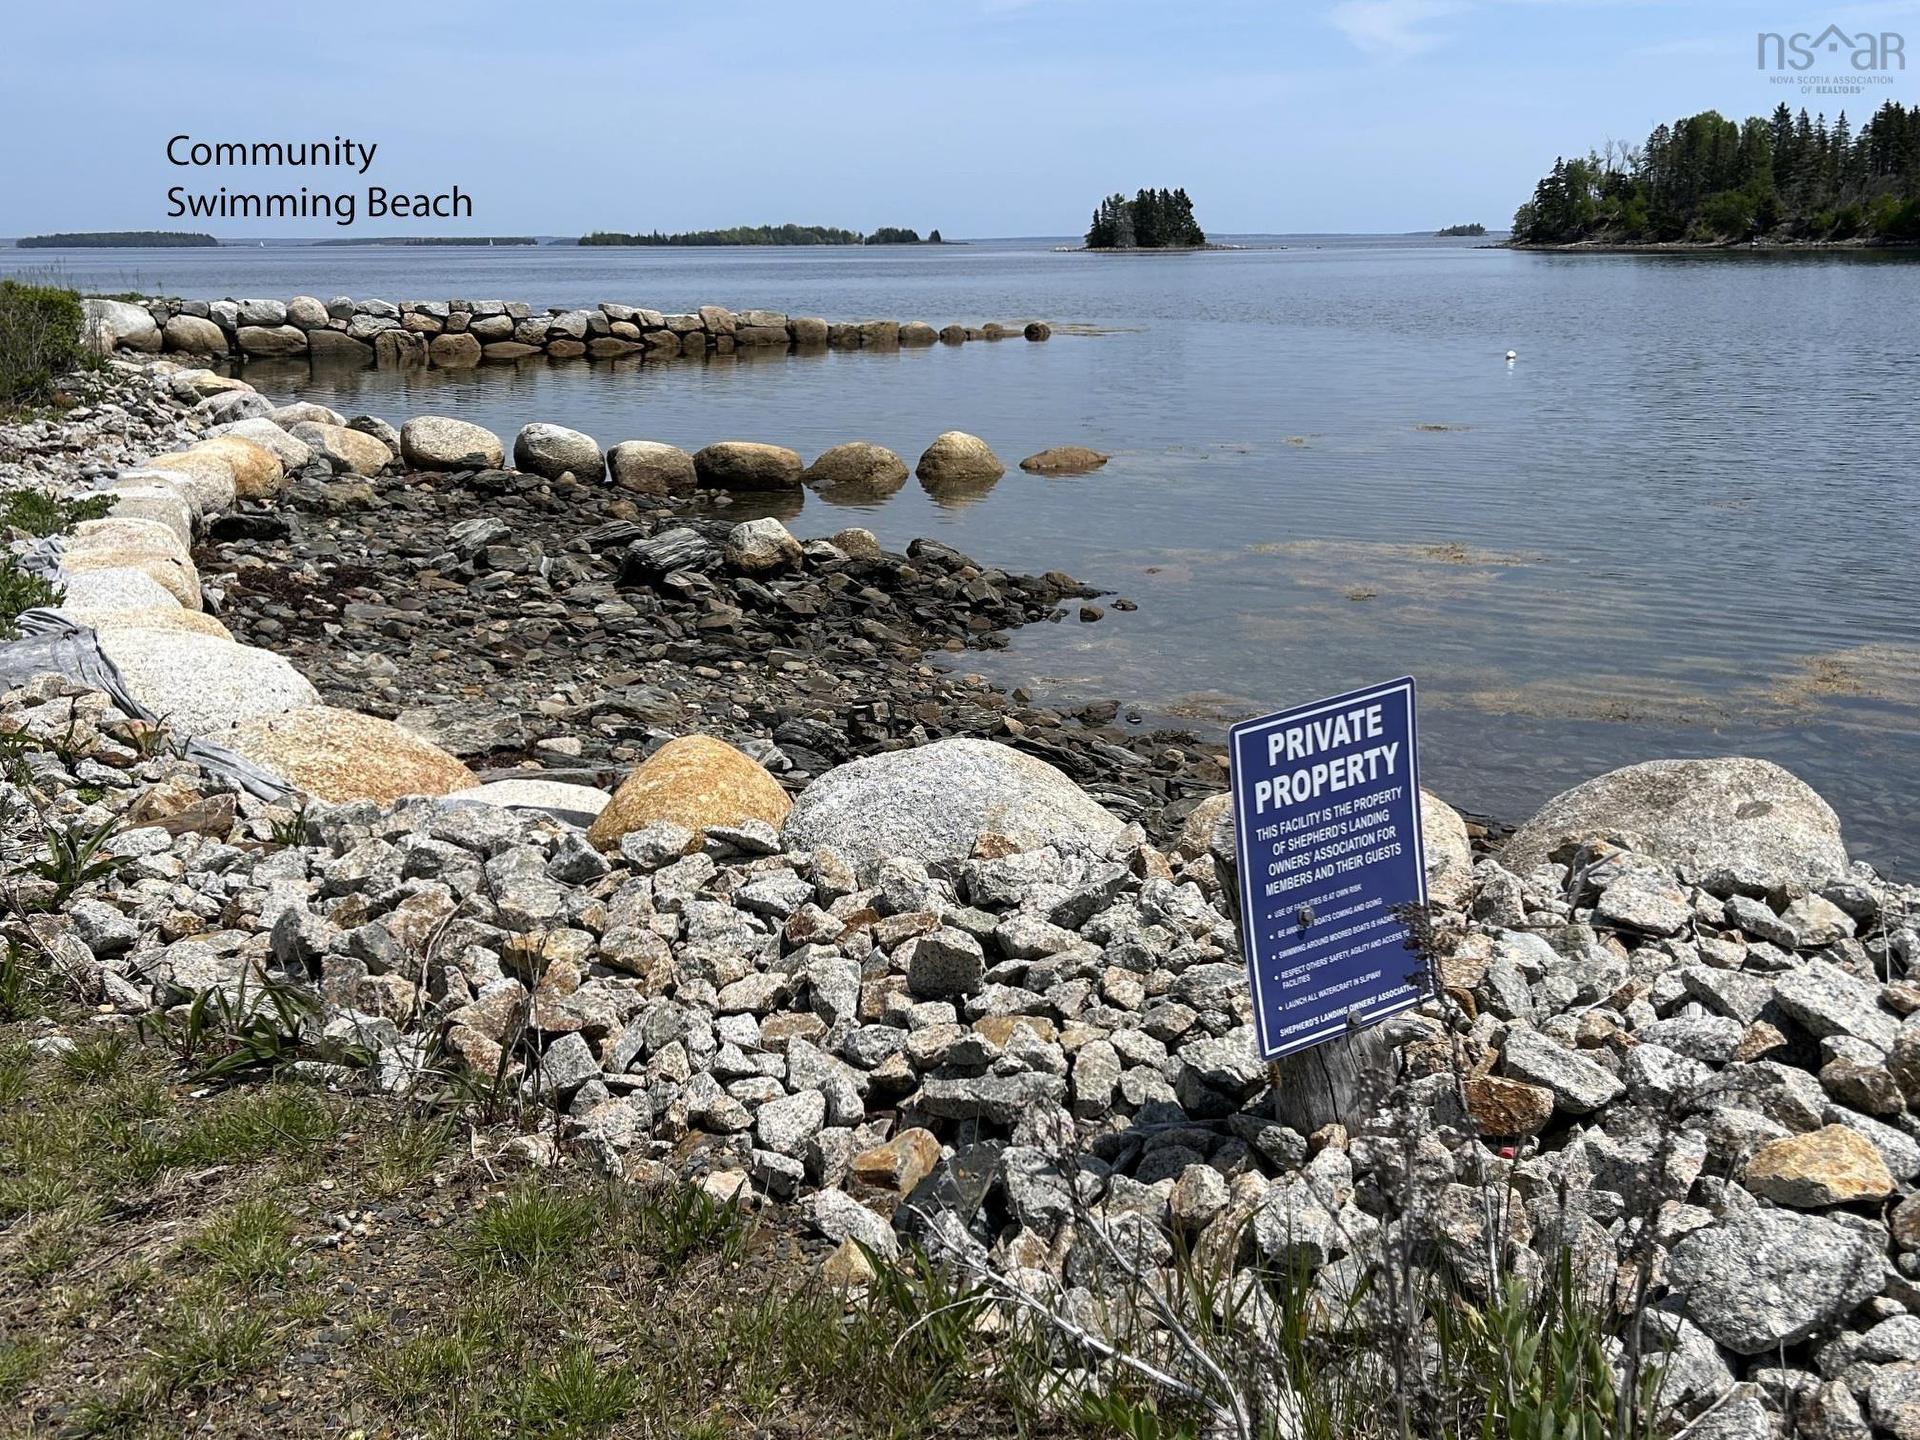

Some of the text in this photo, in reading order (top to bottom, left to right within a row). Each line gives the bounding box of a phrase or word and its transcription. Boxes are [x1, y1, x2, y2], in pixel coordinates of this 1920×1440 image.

[1267, 704, 1384, 767] PRIVATE
[1254, 741, 1399, 815] PROPERTY
[1256, 786, 1403, 842] THIS FACILITY IS THE PROPERTY
[1272, 809, 1390, 856] OF SHEPHERD'S LANDING
[1265, 842, 1402, 897] MEMBERS AND THEIR GUESTS
[1268, 825, 1397, 877] OWNERS' ASSOCIATION FOR
[1274, 883, 1362, 918] USE OF FACILITIES IS AT OWN RISK
[1277, 929, 1286, 938] BE
[1313, 913, 1332, 926] BOATS
[1332, 905, 1353, 920] COMING
[1353, 902, 1365, 913] AND
[1365, 897, 1383, 910] GOING
[1278, 943, 1306, 960] SWIMMING
[1306, 935, 1329, 950] AROUND
[1329, 928, 1352, 943] MOORED
[1352, 921, 1370, 935] BOATS
[1370, 919, 1376, 928] IS
[1281, 964, 1306, 980] RESPECT
[1350, 943, 1370, 956] AGILITY
[1370, 938, 1382, 948] AND
[1382, 932, 1402, 944] ACCESS
[1402, 929, 1410, 938] TO
[1282, 973, 1311, 990] FACILITIES
[1285, 969, 1382, 1010] LAUNCH ALL WATERCRAFT IN SLIPWAY
[1320, 1006, 1348, 1023] LANDING
